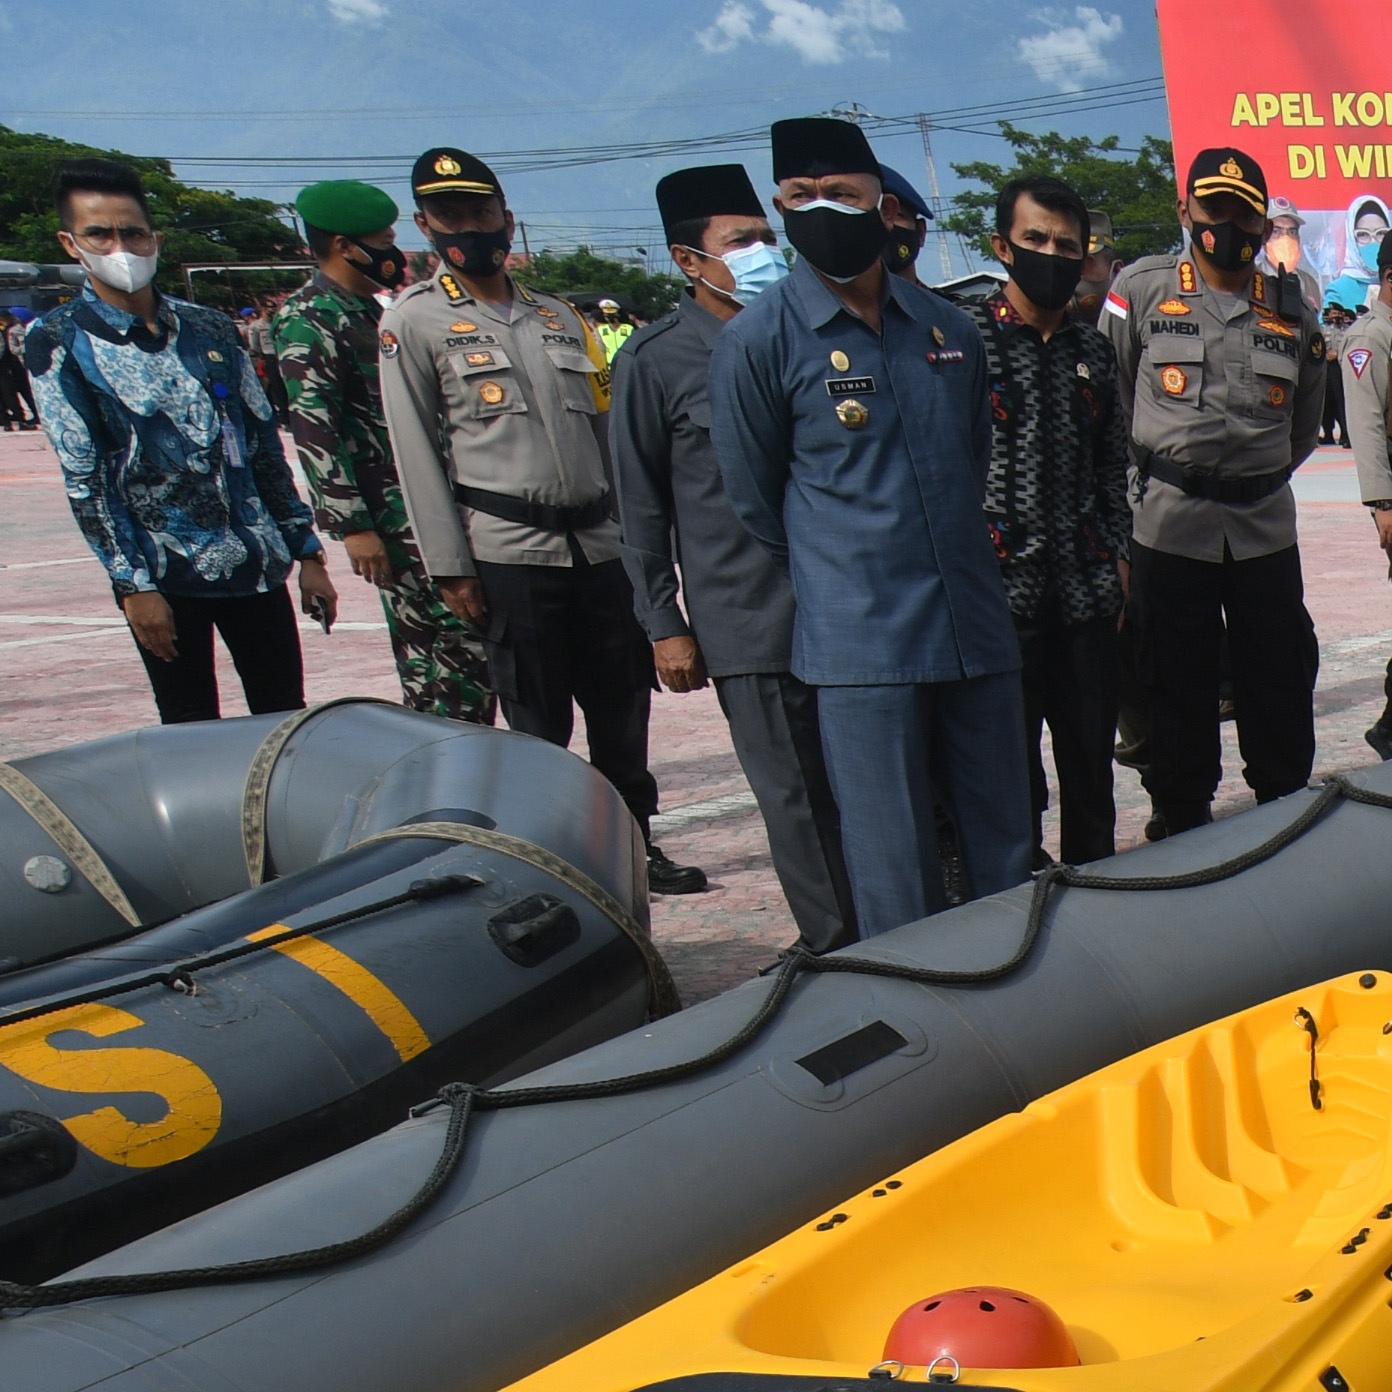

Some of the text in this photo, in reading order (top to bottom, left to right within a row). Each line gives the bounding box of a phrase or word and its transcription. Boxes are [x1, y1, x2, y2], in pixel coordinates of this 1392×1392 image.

[1230, 92, 1324, 126] APEL
[1287, 144, 1327, 178] DI
[1150, 320, 1199, 336] MAHEDI
[446, 335, 496, 348] DIDIK.S
[542, 334, 581, 347] POLRI
[1253, 334, 1299, 358] POLRI
[834, 382, 867, 391] USMAN
